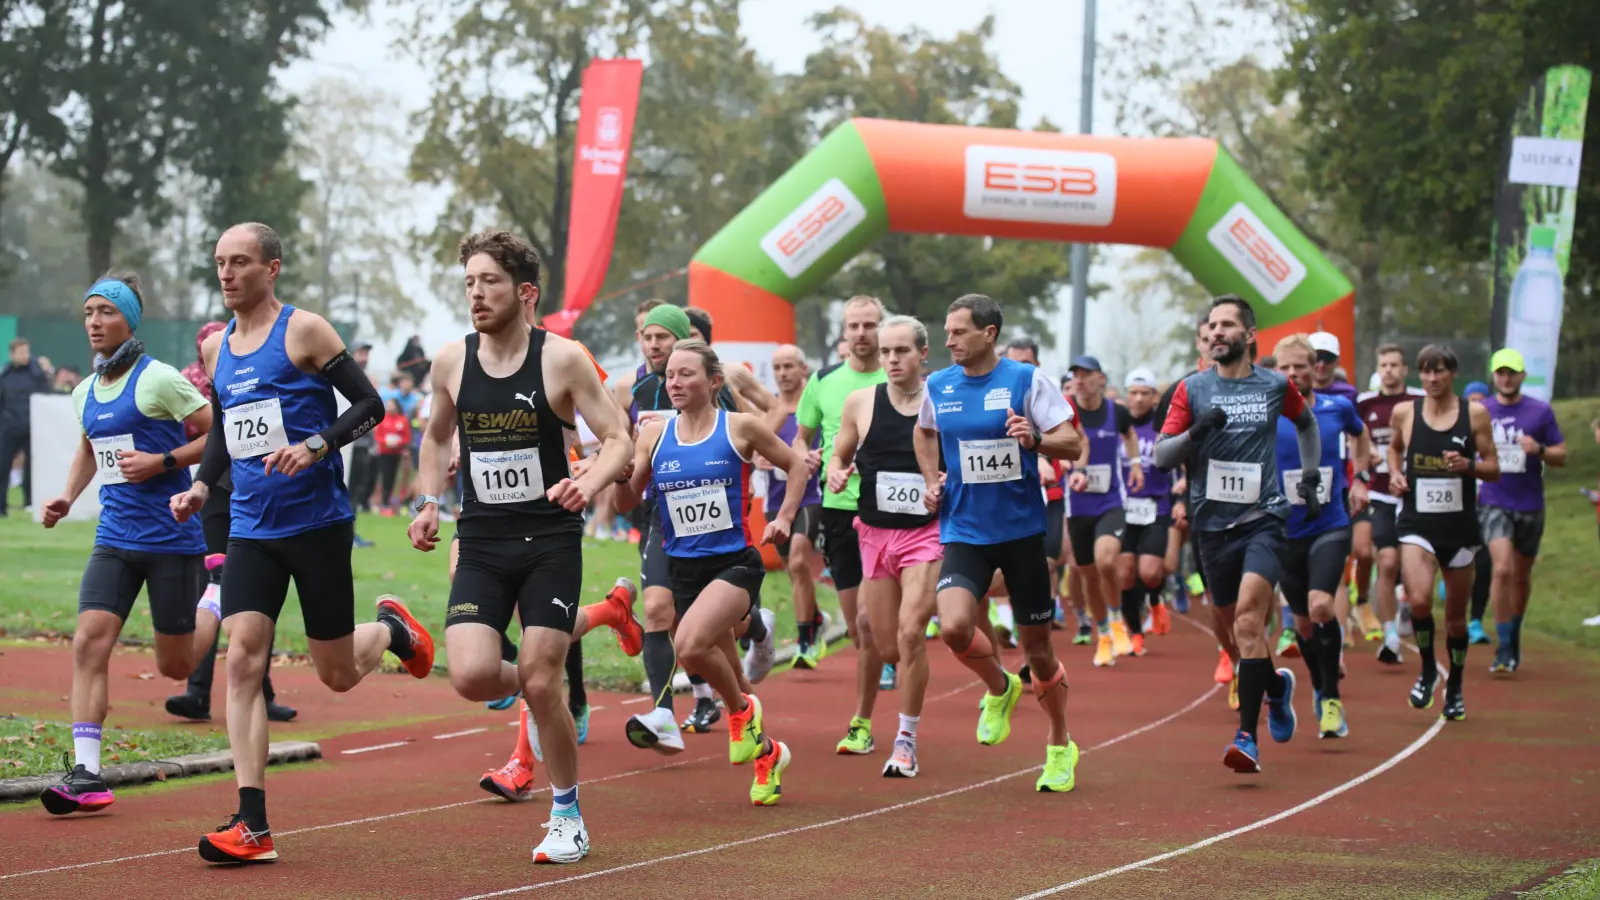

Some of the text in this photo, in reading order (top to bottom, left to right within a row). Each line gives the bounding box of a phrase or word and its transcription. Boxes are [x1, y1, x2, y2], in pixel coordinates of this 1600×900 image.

[984, 161, 1097, 196] ESB
[777, 195, 844, 258] ESB
[1229, 217, 1291, 282] ESB
[1226, 413, 1268, 425] RATHON
[233, 416, 269, 441] 726
[352, 416, 376, 439] BORA
[240, 440, 270, 451] SILENCA
[477, 453, 533, 464] Schweiger Bräu
[967, 452, 1014, 472] 1144
[482, 467, 529, 490] 1101
[976, 473, 1007, 481] SILENCA
[1221, 475, 1244, 491] 111
[658, 480, 696, 491] BECK
[490, 491, 526, 501] SILENCA
[671, 488, 720, 501] Schweiger Bräu
[887, 486, 920, 503] 260
[1426, 490, 1453, 503] 528
[676, 500, 721, 524] 1076
[686, 523, 716, 533] SILENCA
